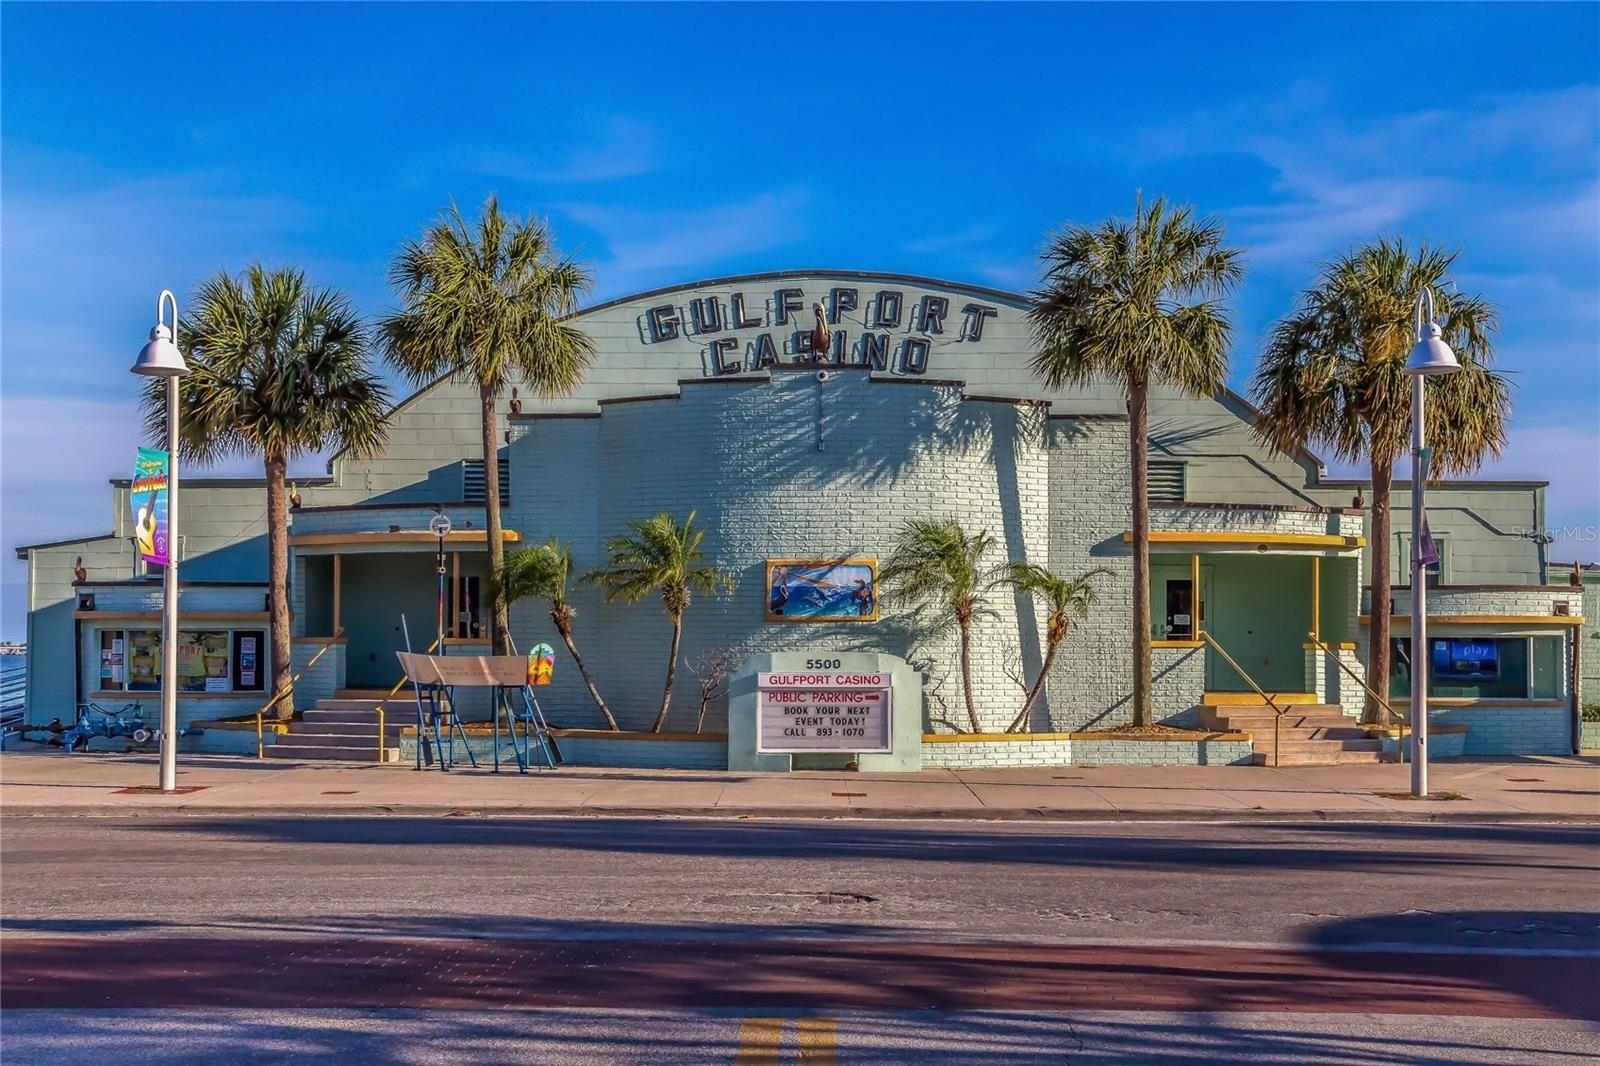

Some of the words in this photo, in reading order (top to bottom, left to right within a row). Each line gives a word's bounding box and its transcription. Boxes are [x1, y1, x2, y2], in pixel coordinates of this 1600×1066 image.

[645, 287, 998, 343] GULFPORT
[1463, 643, 1489, 656] play
[806, 659, 841, 669] 5500
[769, 675, 831, 685] GULFPORT
[836, 675, 881, 685] CASINO
[768, 692, 806, 703] PUBLIC
[812, 692, 864, 703] PARKING
[784, 706, 809, 715] BOOK
[815, 706, 840, 715] YOUR
[847, 706, 871, 715] NEXT
[795, 717, 823, 726] EVENT
[830, 717, 866, 726] TODAY!
[784, 728, 806, 737] CALL
